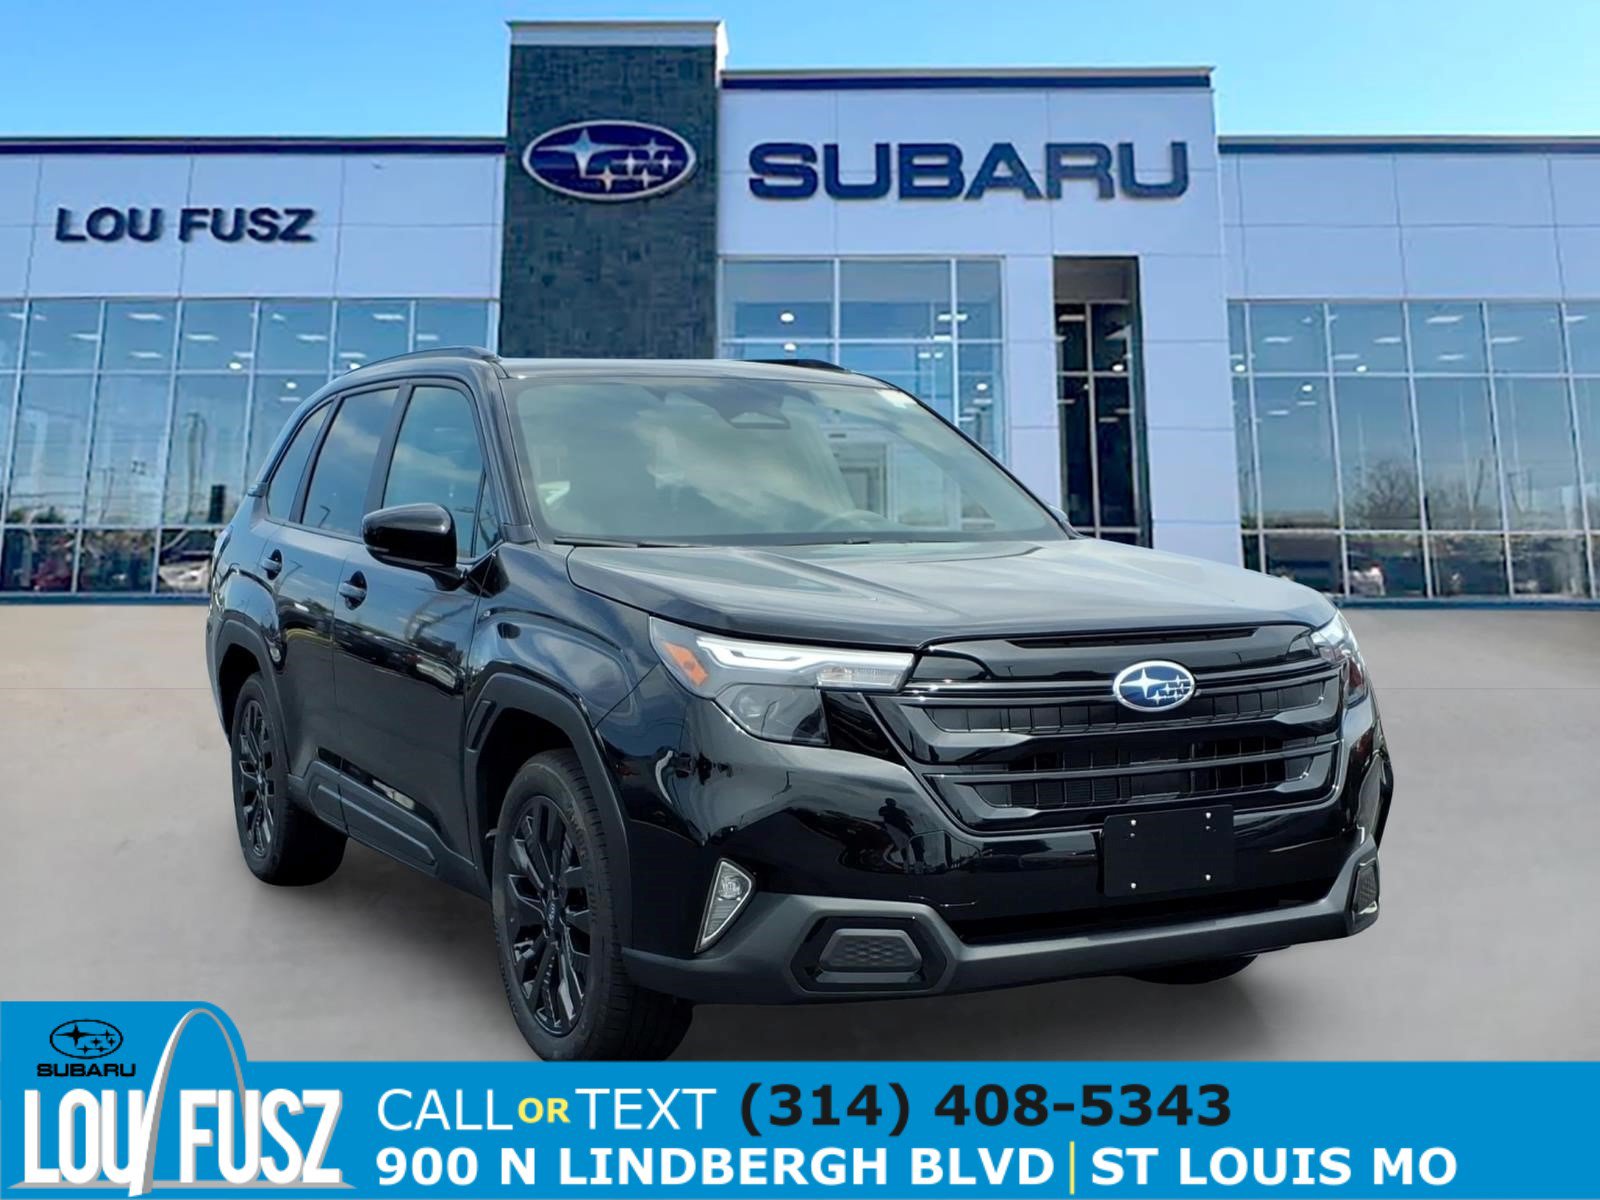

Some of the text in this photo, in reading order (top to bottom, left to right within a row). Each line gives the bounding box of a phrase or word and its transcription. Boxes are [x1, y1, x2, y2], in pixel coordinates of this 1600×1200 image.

[748, 141, 1190, 201] SUBARU
[55, 206, 318, 243] LOU FUSZ
